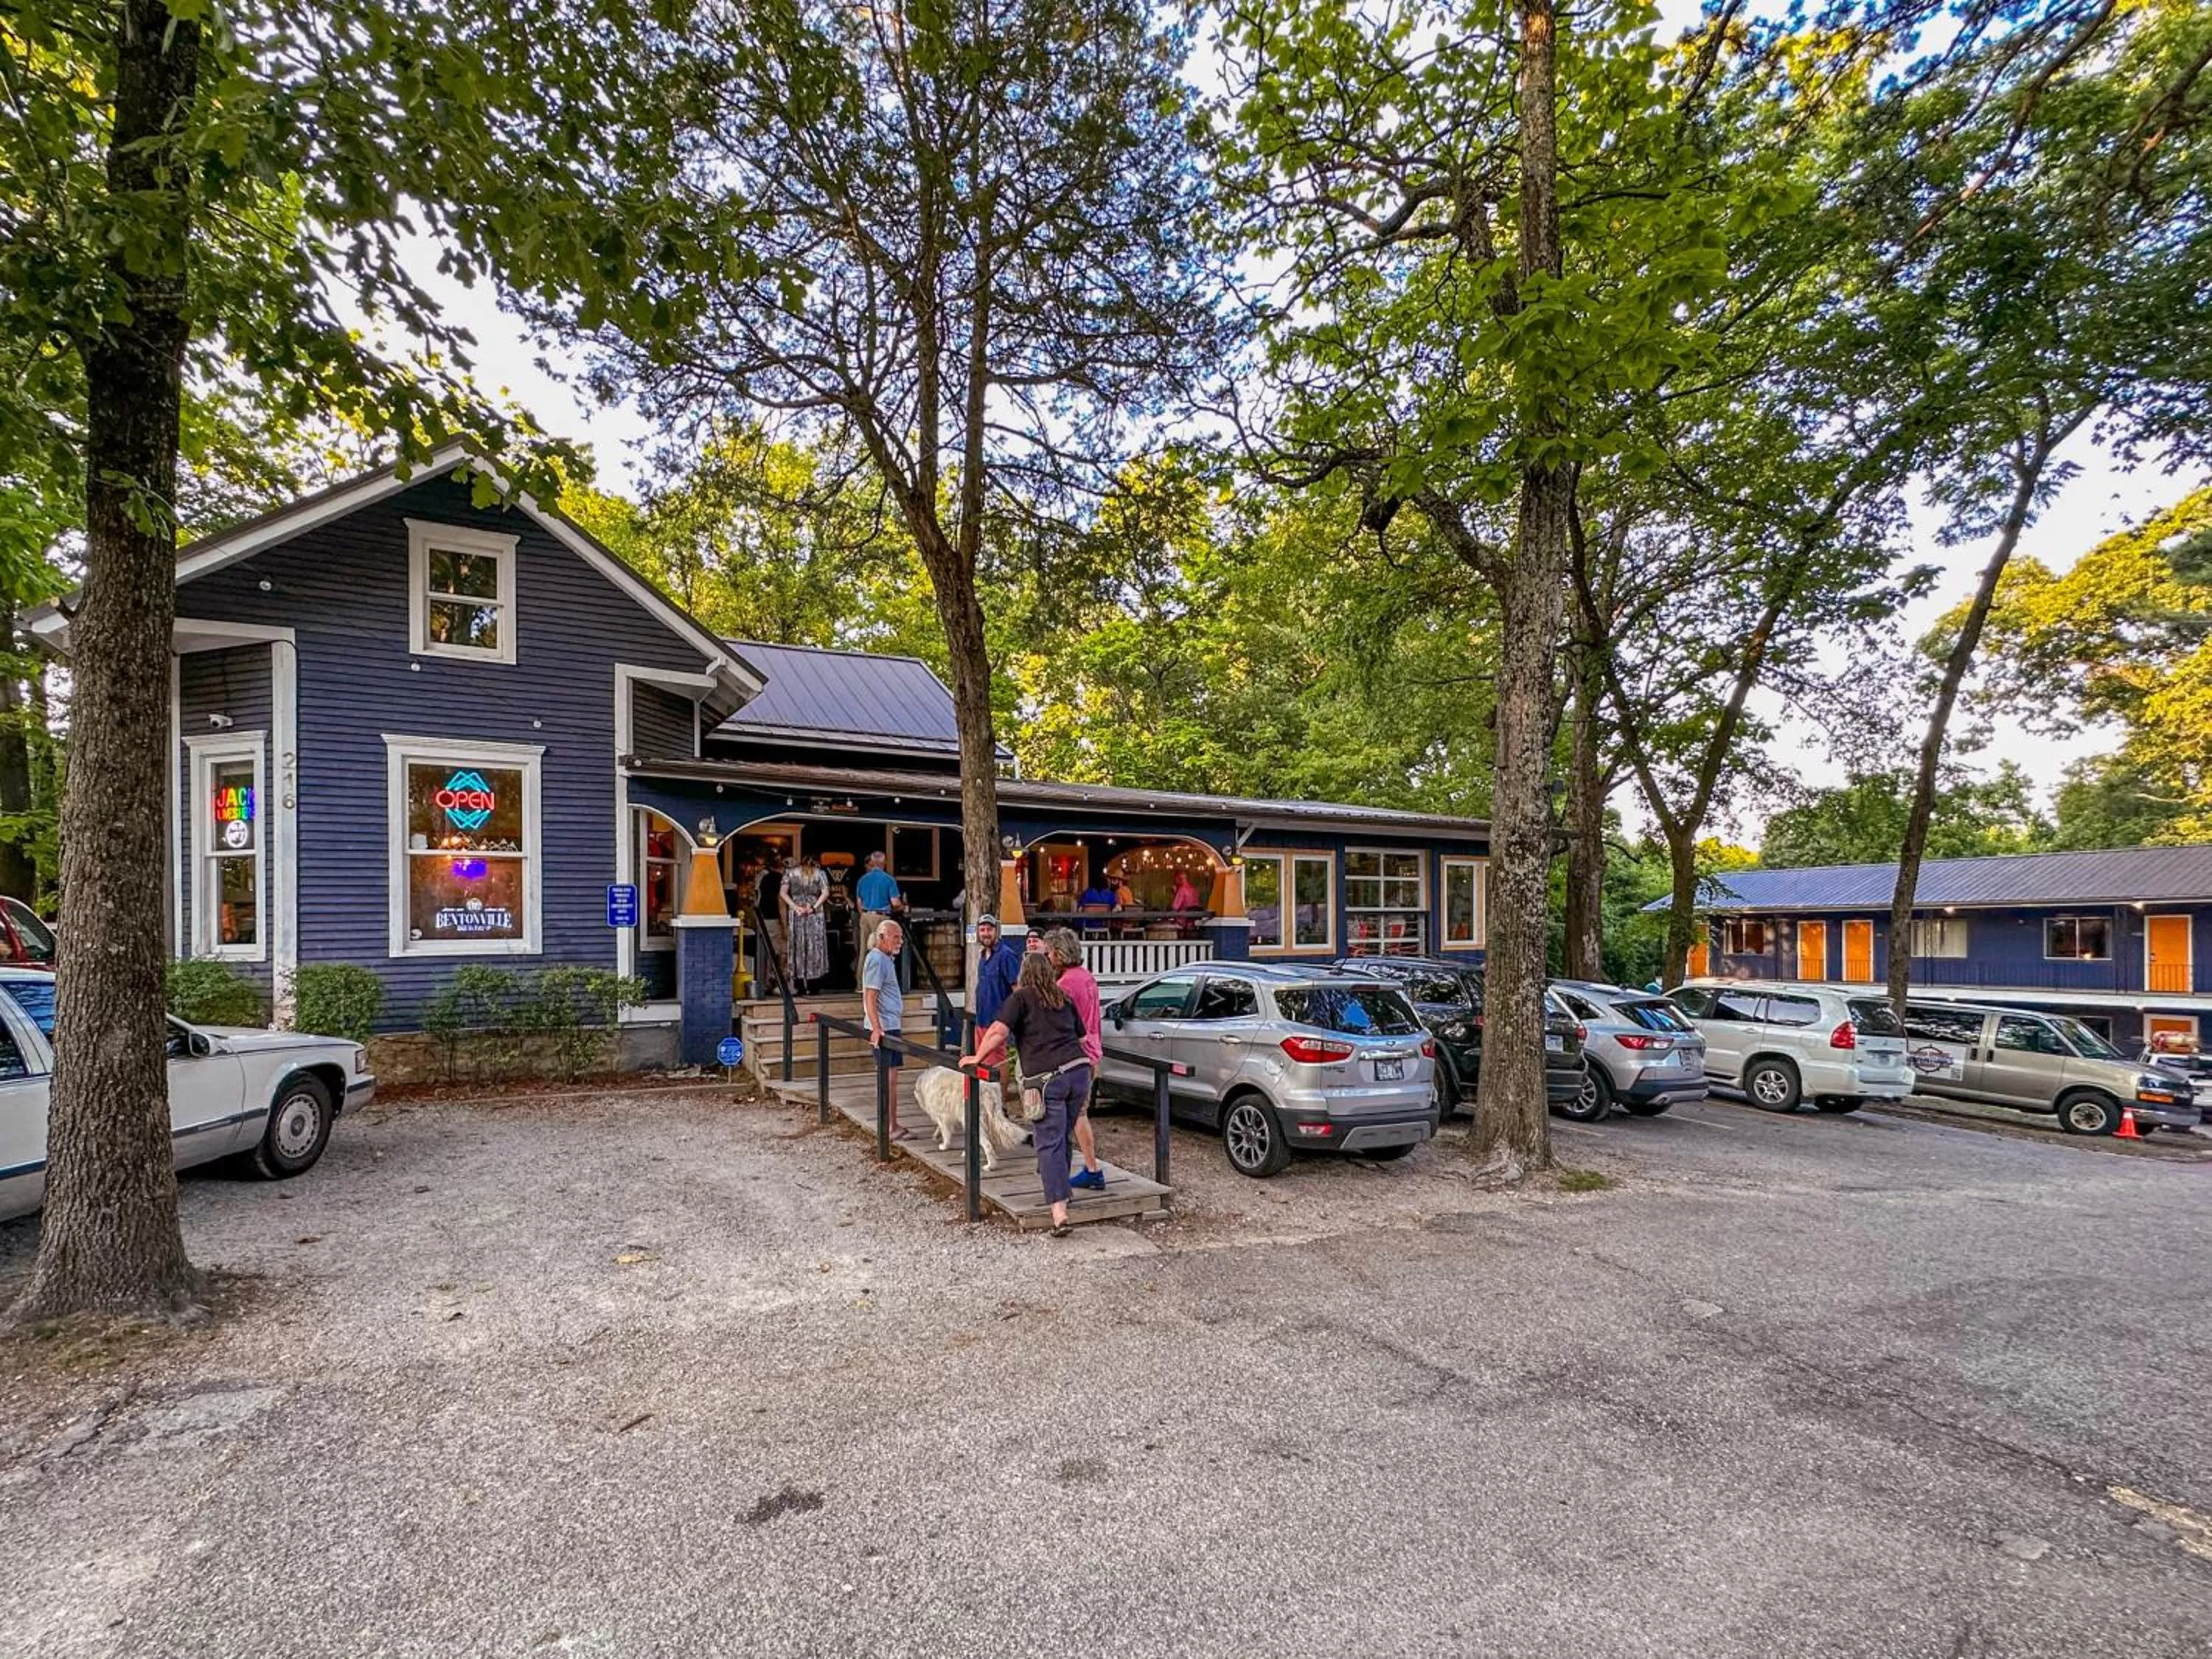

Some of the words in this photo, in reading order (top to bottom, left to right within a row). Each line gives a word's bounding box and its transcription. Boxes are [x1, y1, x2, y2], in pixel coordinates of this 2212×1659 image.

[282, 752, 295, 810] 216
[436, 790, 495, 810] OPEN
[436, 911, 512, 928] BENTONVILLE
